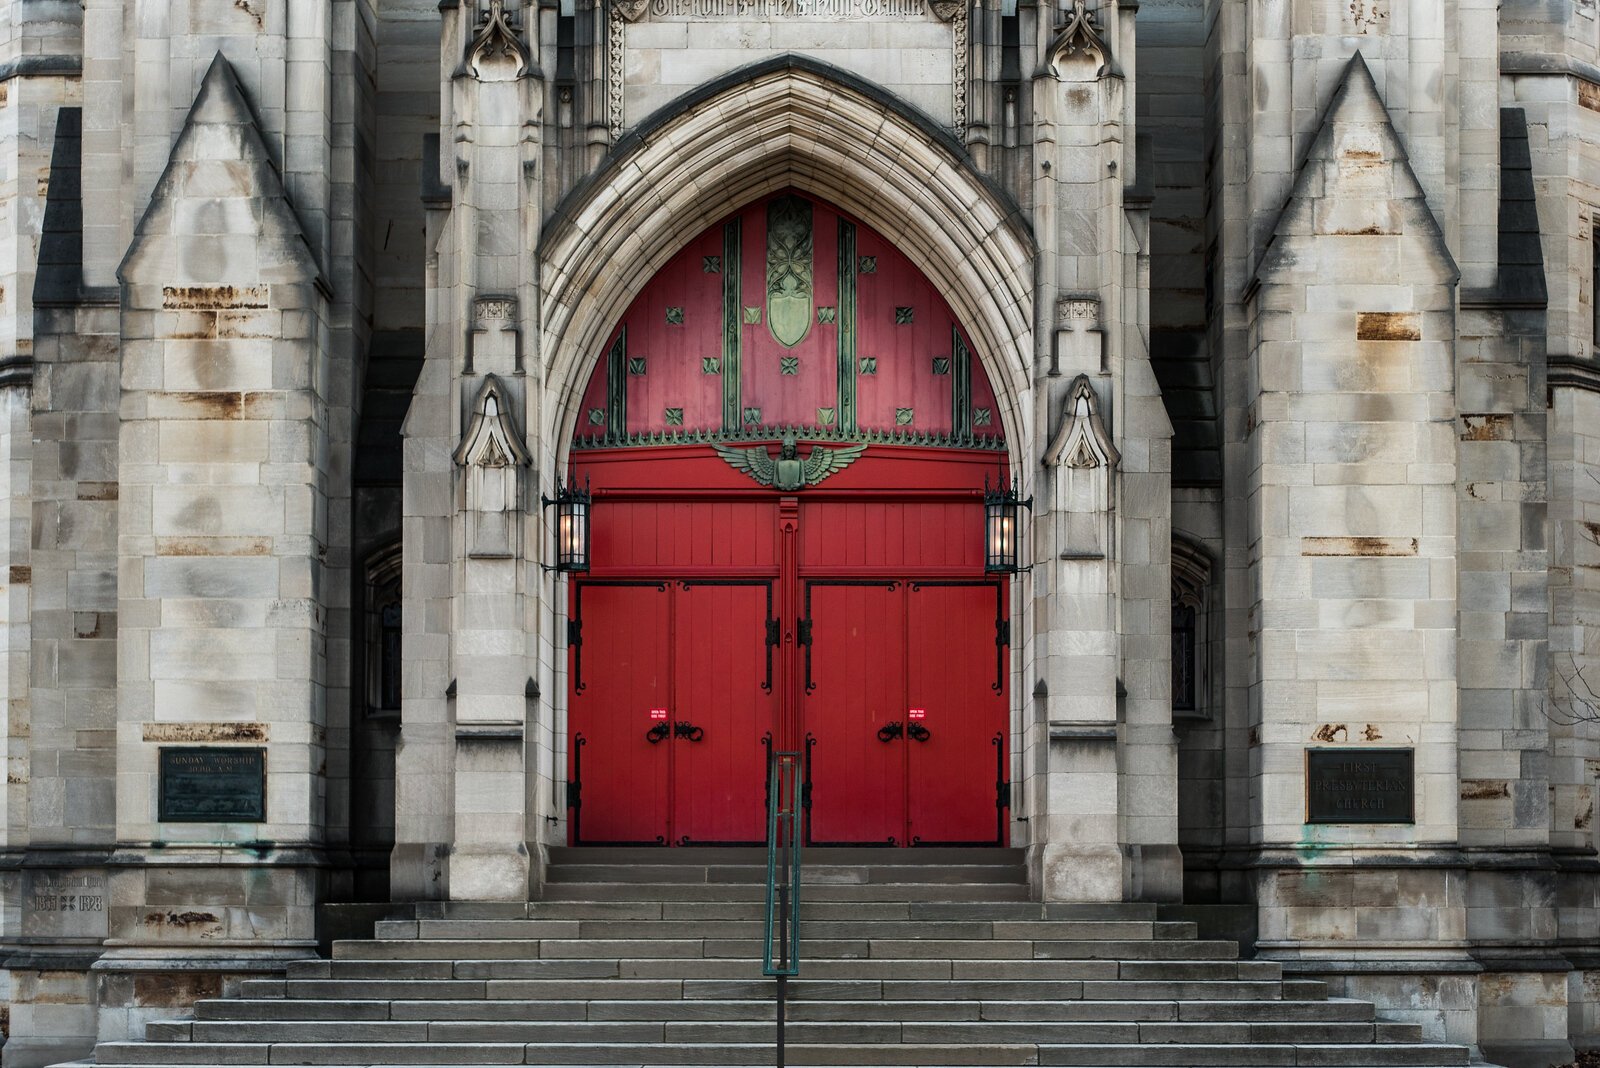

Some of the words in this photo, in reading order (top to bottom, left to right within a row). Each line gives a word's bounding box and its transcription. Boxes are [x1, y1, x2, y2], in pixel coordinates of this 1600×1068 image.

[170, 756, 204, 765] SUNDAY
[213, 756, 255, 765] WORSHIP
[1343, 762, 1377, 772] FIRST
[1315, 780, 1406, 791] PRESBYTERIAN
[1336, 799, 1385, 809] CHURCH
